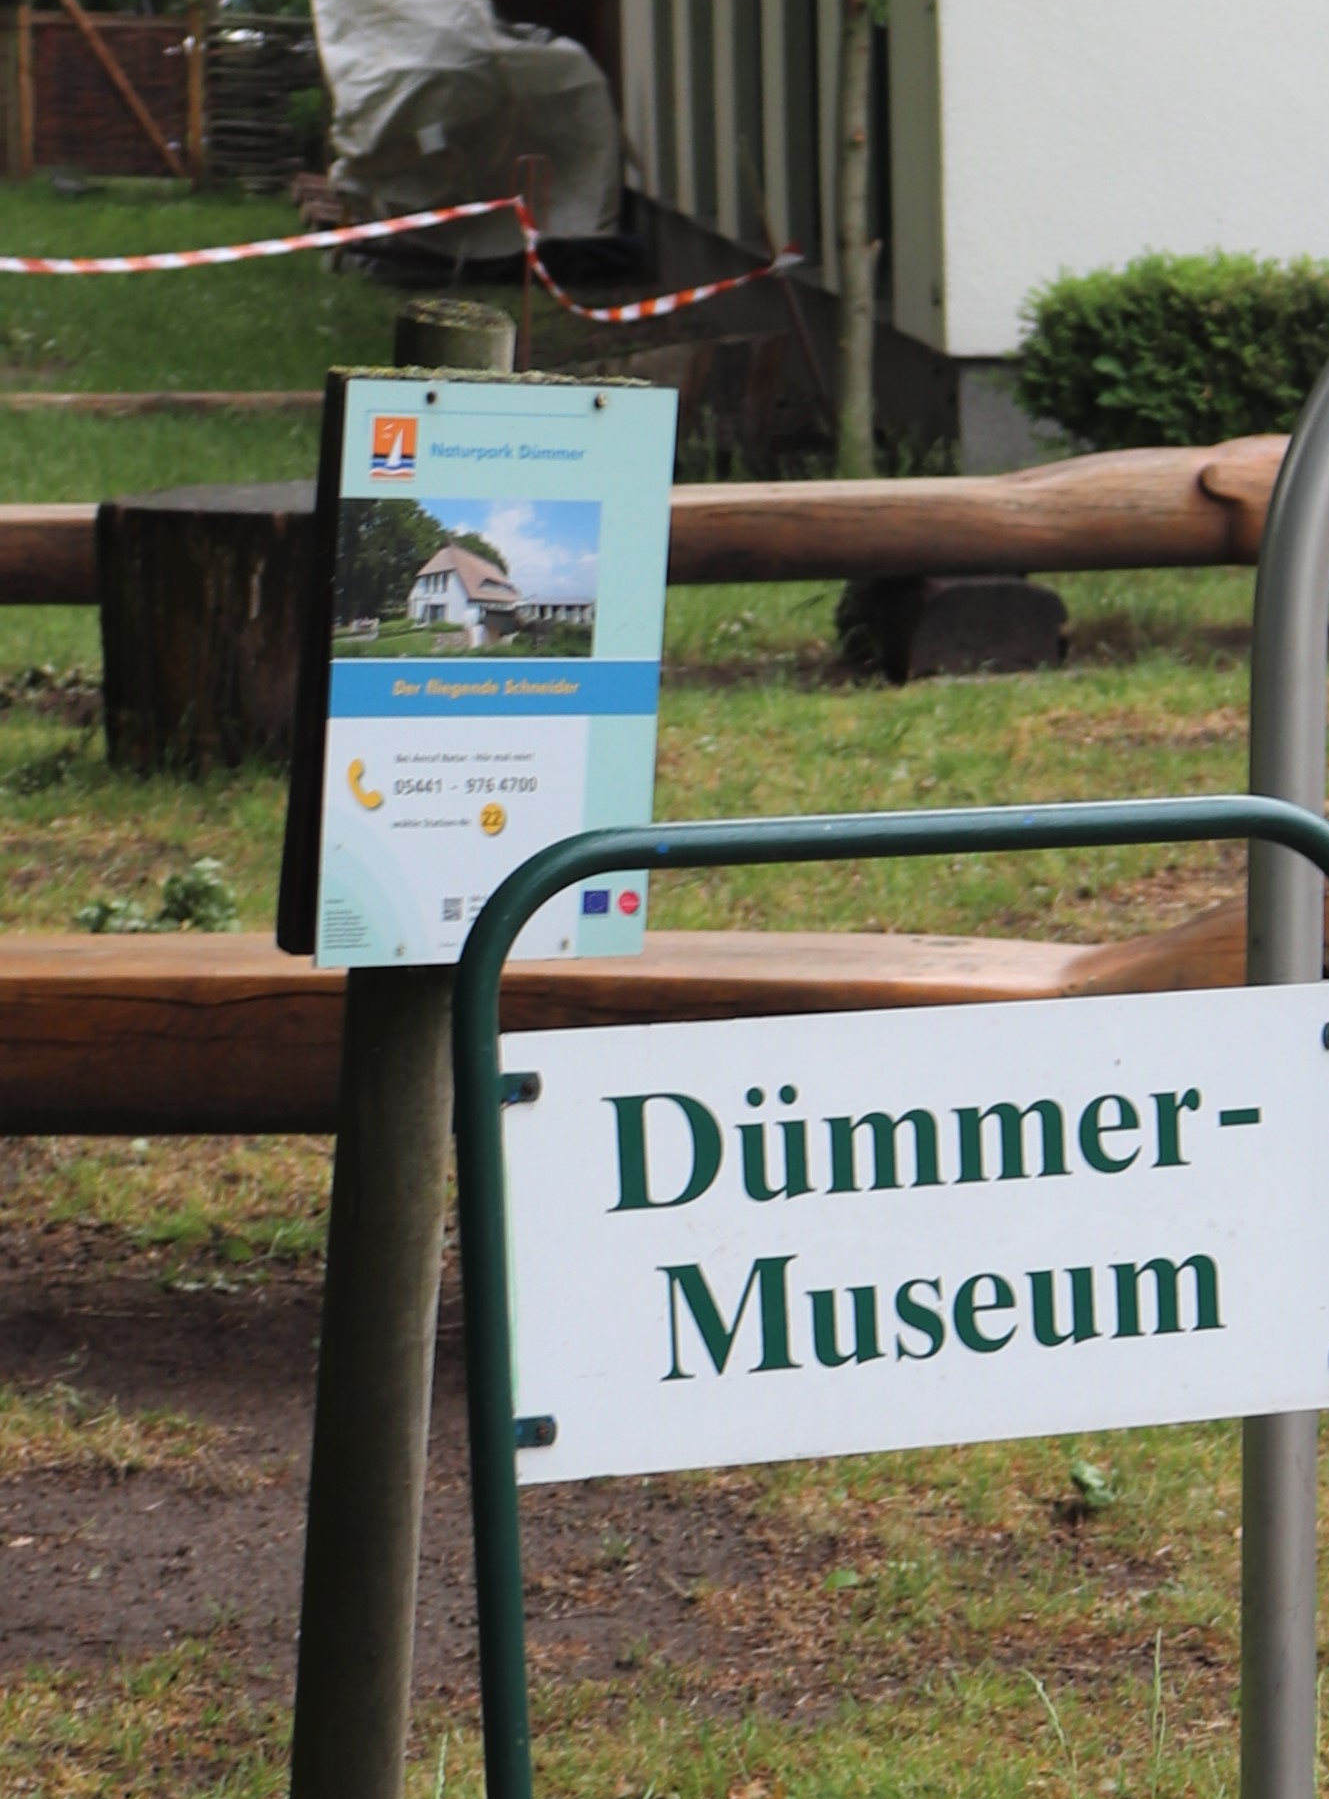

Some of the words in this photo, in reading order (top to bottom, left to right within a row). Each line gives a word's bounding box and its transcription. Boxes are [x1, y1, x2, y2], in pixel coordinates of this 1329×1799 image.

[430, 443, 513, 462] Naturpark
[517, 444, 586, 461] Dümmer
[393, 679, 421, 696] Der
[505, 678, 579, 695] Schneider
[481, 810, 503, 827] 22
[602, 1084, 1262, 1213] Dümmer-
[657, 1253, 1227, 1381] Museum
